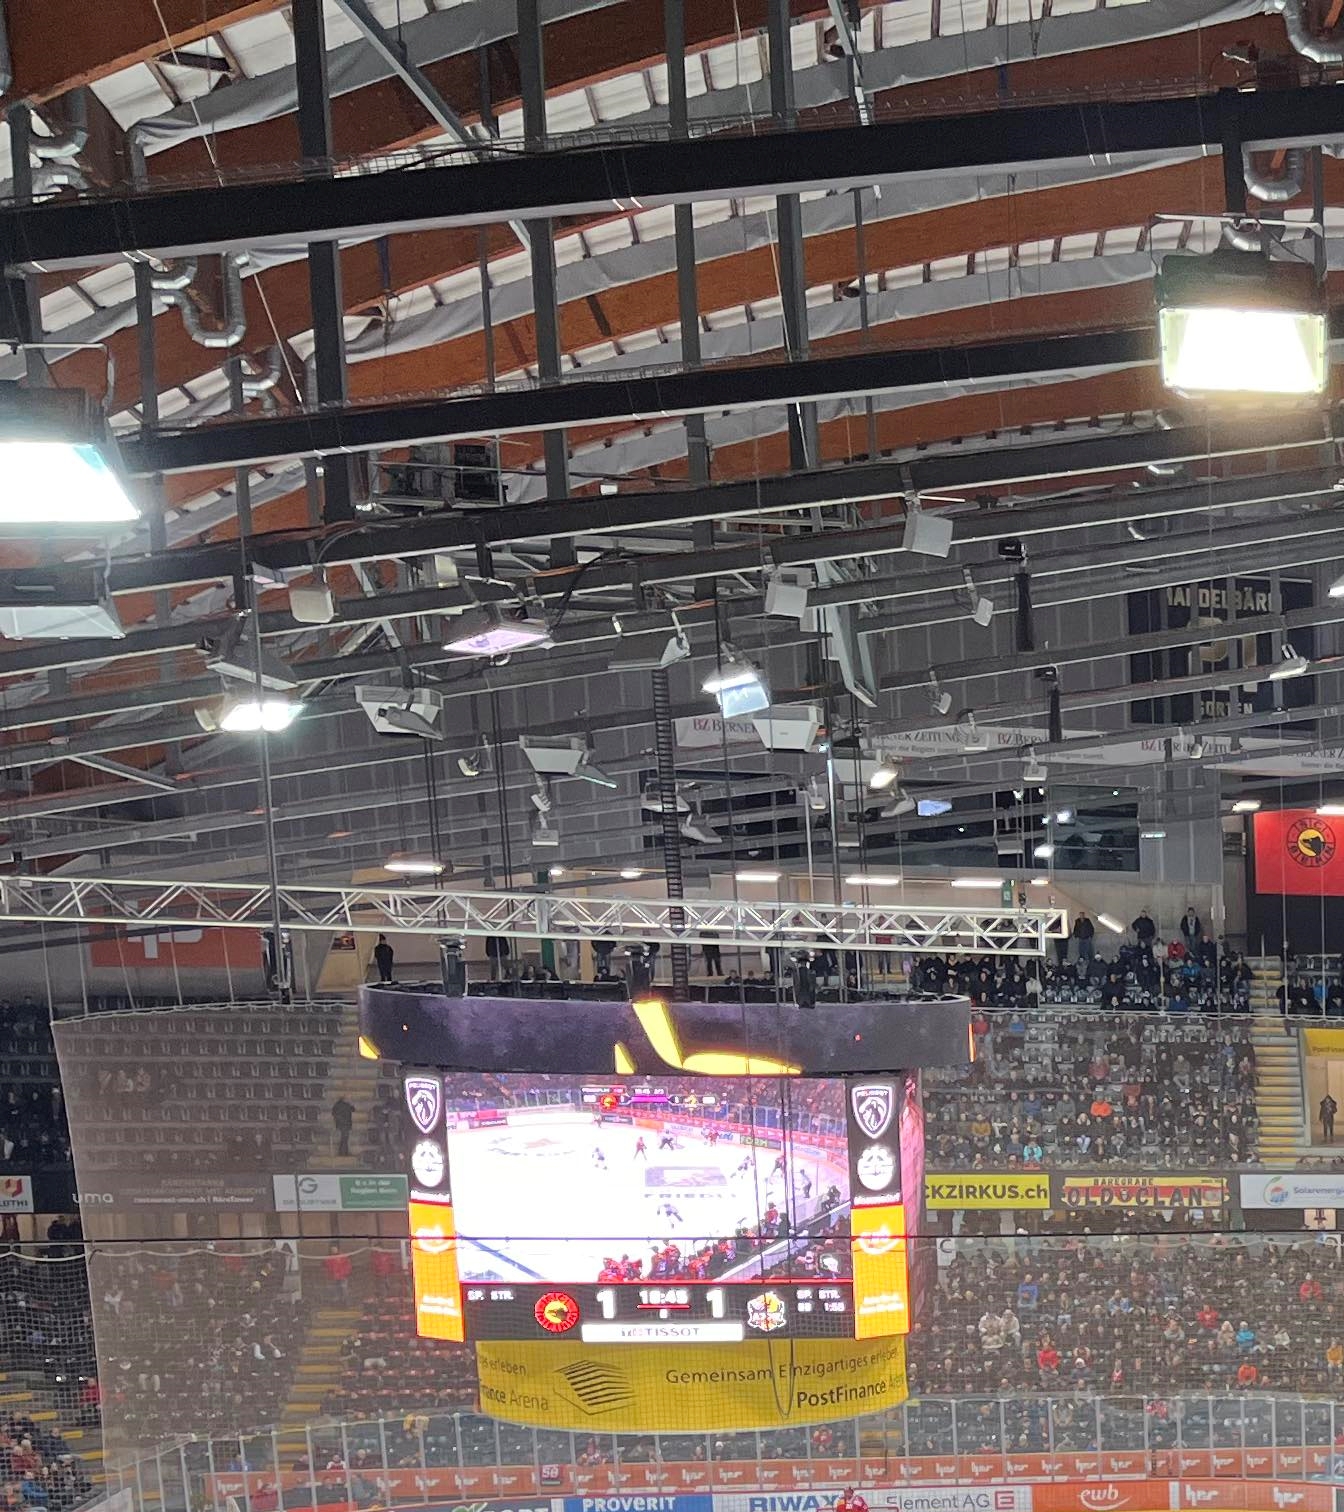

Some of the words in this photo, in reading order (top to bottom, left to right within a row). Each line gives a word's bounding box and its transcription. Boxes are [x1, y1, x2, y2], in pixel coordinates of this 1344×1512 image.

[1141, 740, 1155, 752] BZ
[1135, 1187, 1204, 1207] CLAN
[596, 1289, 616, 1319] 1
[706, 1288, 724, 1318] 1
[643, 1328, 700, 1337] TISSOT
[665, 1367, 773, 1384] Gemeinsam
[778, 1353, 868, 1379] Einzigartiges
[509, 1387, 549, 1411] Arena
[796, 1380, 886, 1409] PostFinance
[962, 1493, 991, 1509] AG
[1080, 1483, 1119, 1501] ewb
